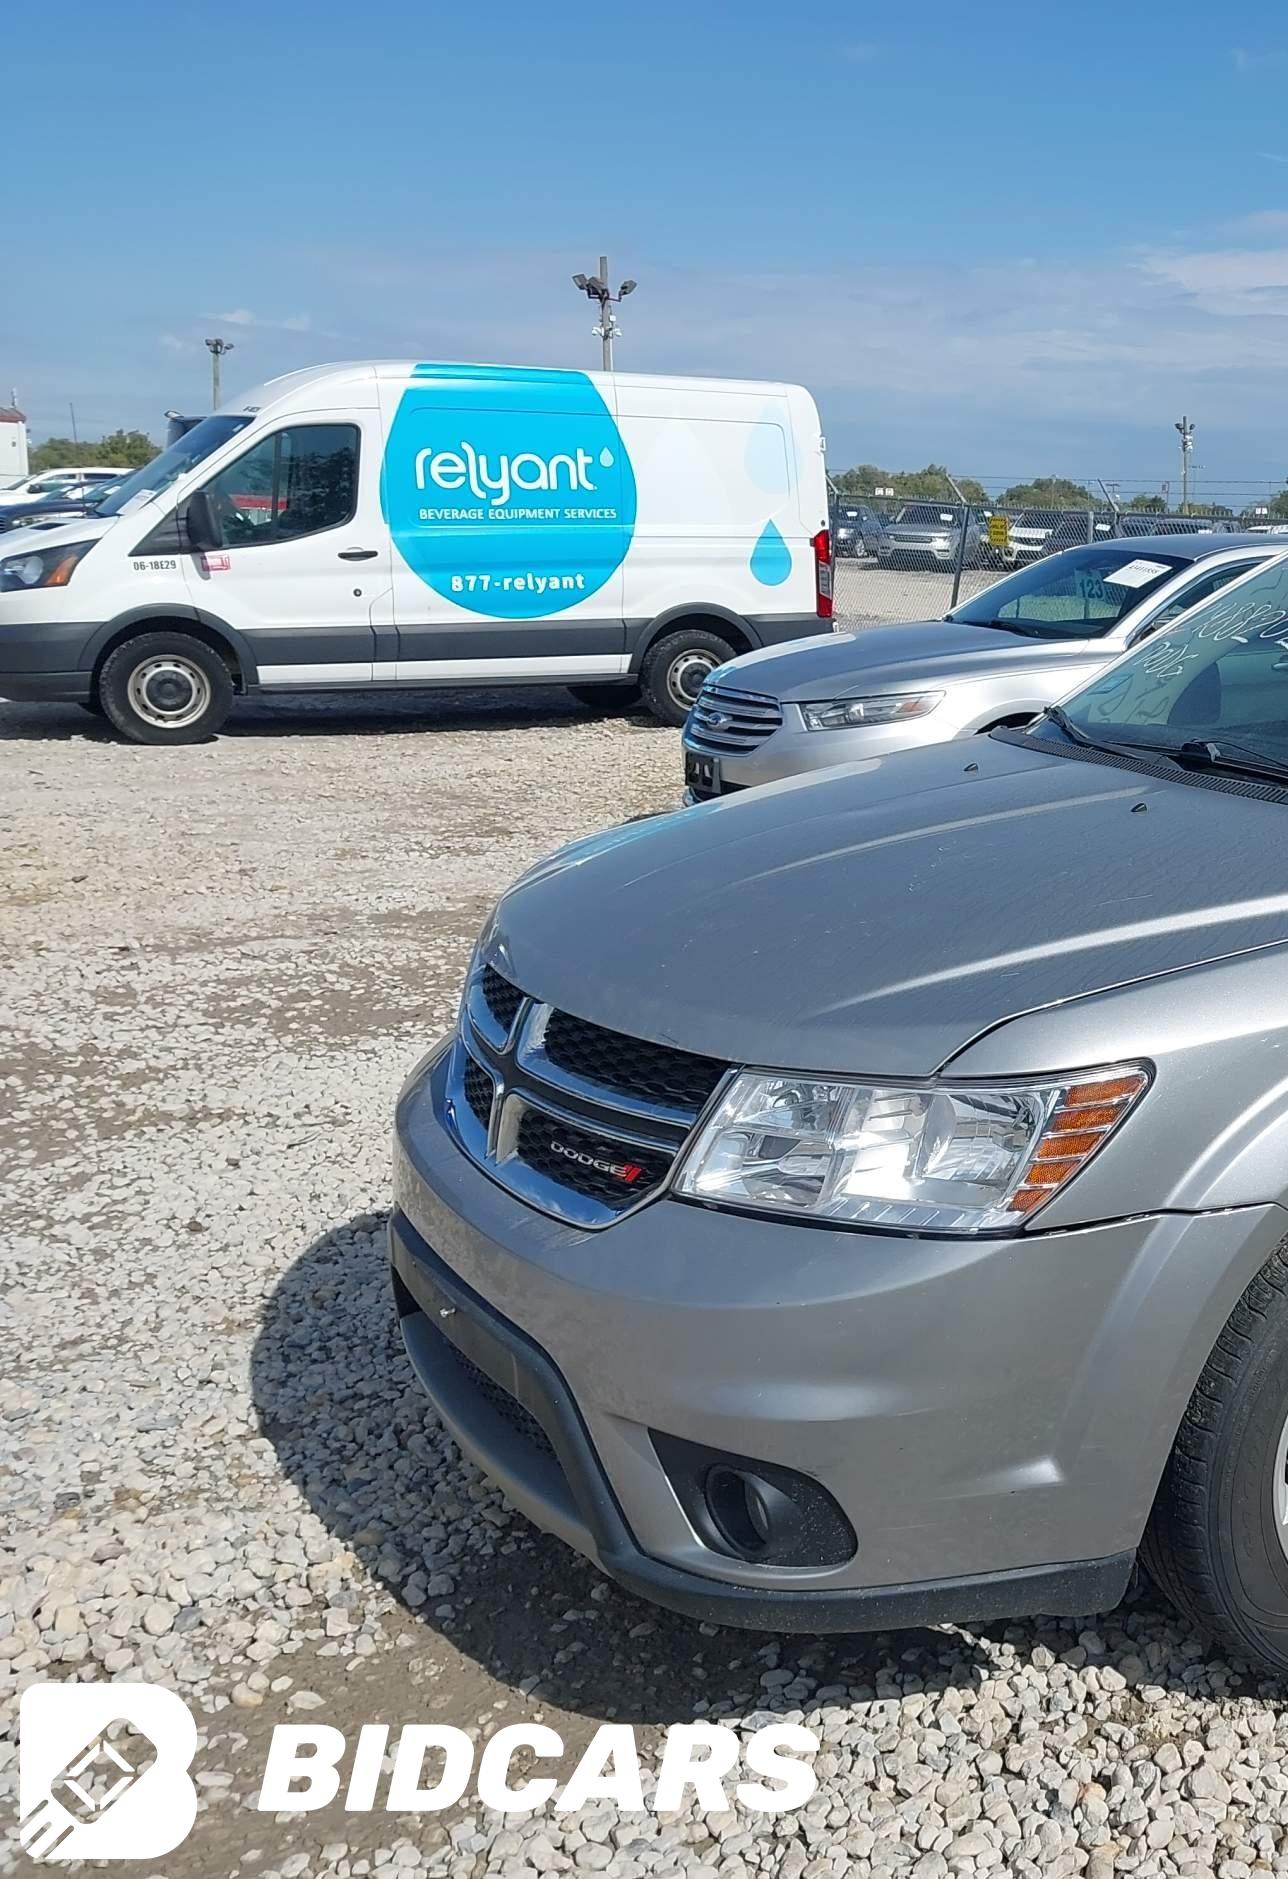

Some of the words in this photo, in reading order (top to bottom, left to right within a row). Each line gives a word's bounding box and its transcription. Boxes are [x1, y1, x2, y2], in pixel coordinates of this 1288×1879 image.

[415, 441, 594, 506] relyant
[419, 508, 484, 520] BEVERAGE
[488, 508, 560, 520] EQUIPMENT
[564, 508, 617, 519] SERVICES
[451, 572, 585, 594] 877-relyant
[550, 1140, 627, 1176] DODGE
